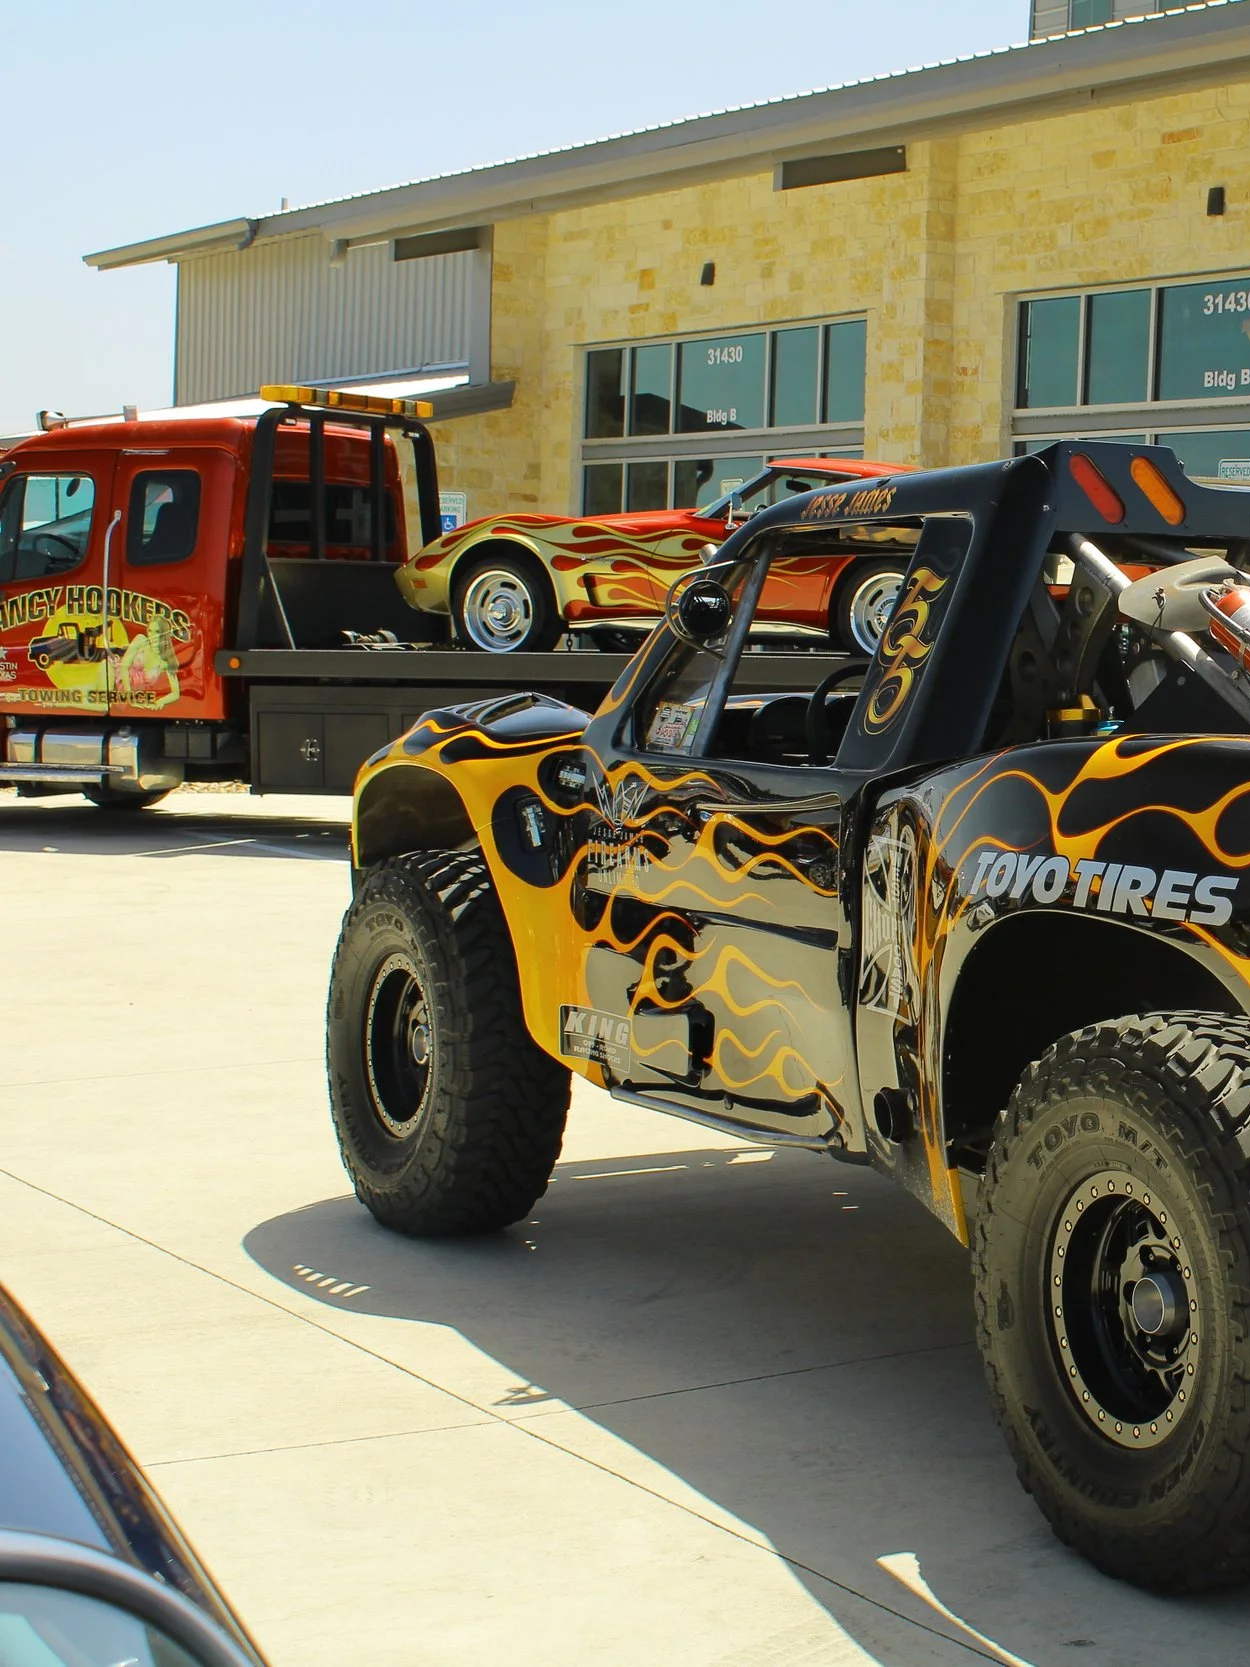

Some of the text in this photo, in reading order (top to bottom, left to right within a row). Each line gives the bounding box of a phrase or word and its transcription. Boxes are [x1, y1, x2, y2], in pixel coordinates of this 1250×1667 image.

[707, 346, 743, 365] 31430
[1204, 369, 1250, 390] Bldg B
[707, 408, 737, 424] Bldg B
[1222, 466, 1250, 477] RESERVED
[18, 688, 156, 705] TOWING SERVICE
[970, 851, 1239, 927] TOYO TIRES
[564, 1011, 629, 1046] KING
[573, 1045, 599, 1057] RACING
[1026, 1112, 1100, 1171] TOYO
[1118, 1120, 1168, 1171] M/T
